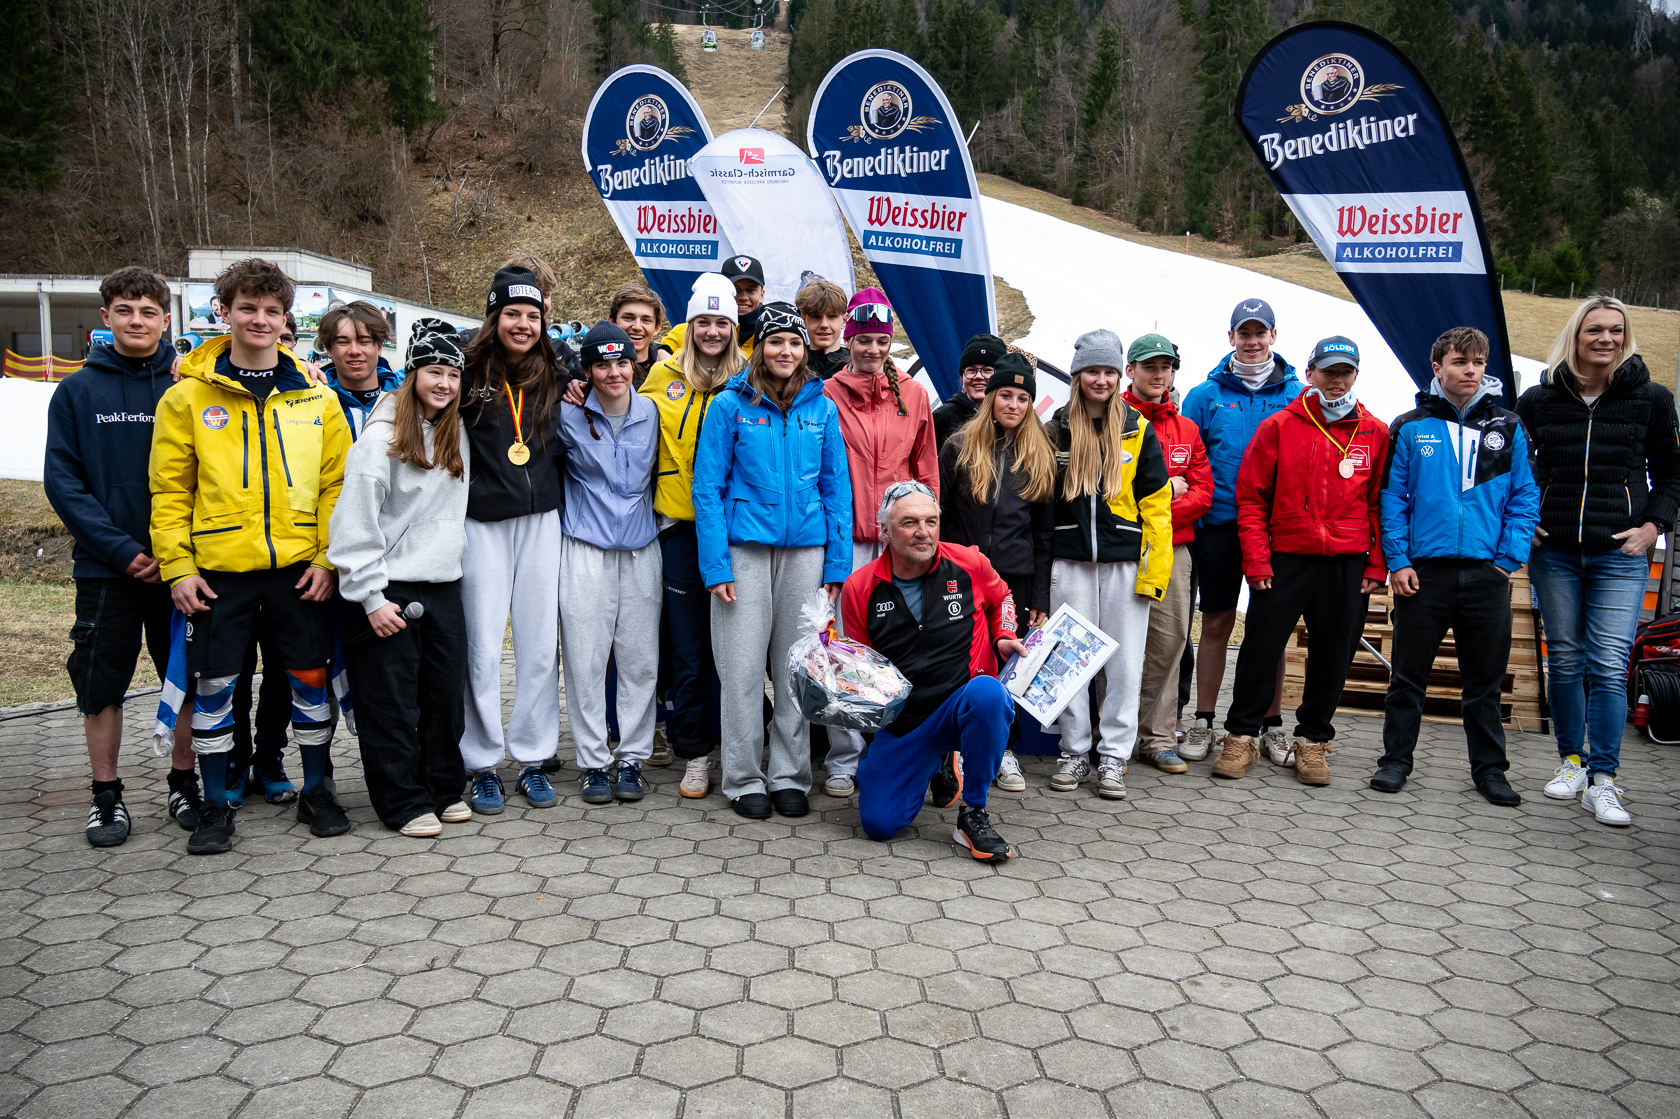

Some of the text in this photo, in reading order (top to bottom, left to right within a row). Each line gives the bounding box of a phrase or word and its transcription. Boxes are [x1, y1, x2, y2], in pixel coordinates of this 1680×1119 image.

[1304, 57, 1361, 90] BENEDIKTINER
[629, 98, 667, 126] BENEDIKTINER
[864, 84, 909, 113] BENEDIKTINER
[1258, 112, 1418, 170] Benediktiner
[823, 145, 950, 186] Benediktiner
[867, 195, 967, 232] Weissbier
[1336, 205, 1463, 238] Weissbier
[640, 242, 711, 255] ALKOHOLFREI
[868, 234, 956, 254] ALKOHOLFREI
[1343, 246, 1453, 258] ALKOHOLFREI
[1324, 344, 1355, 353] SÖLDEN
